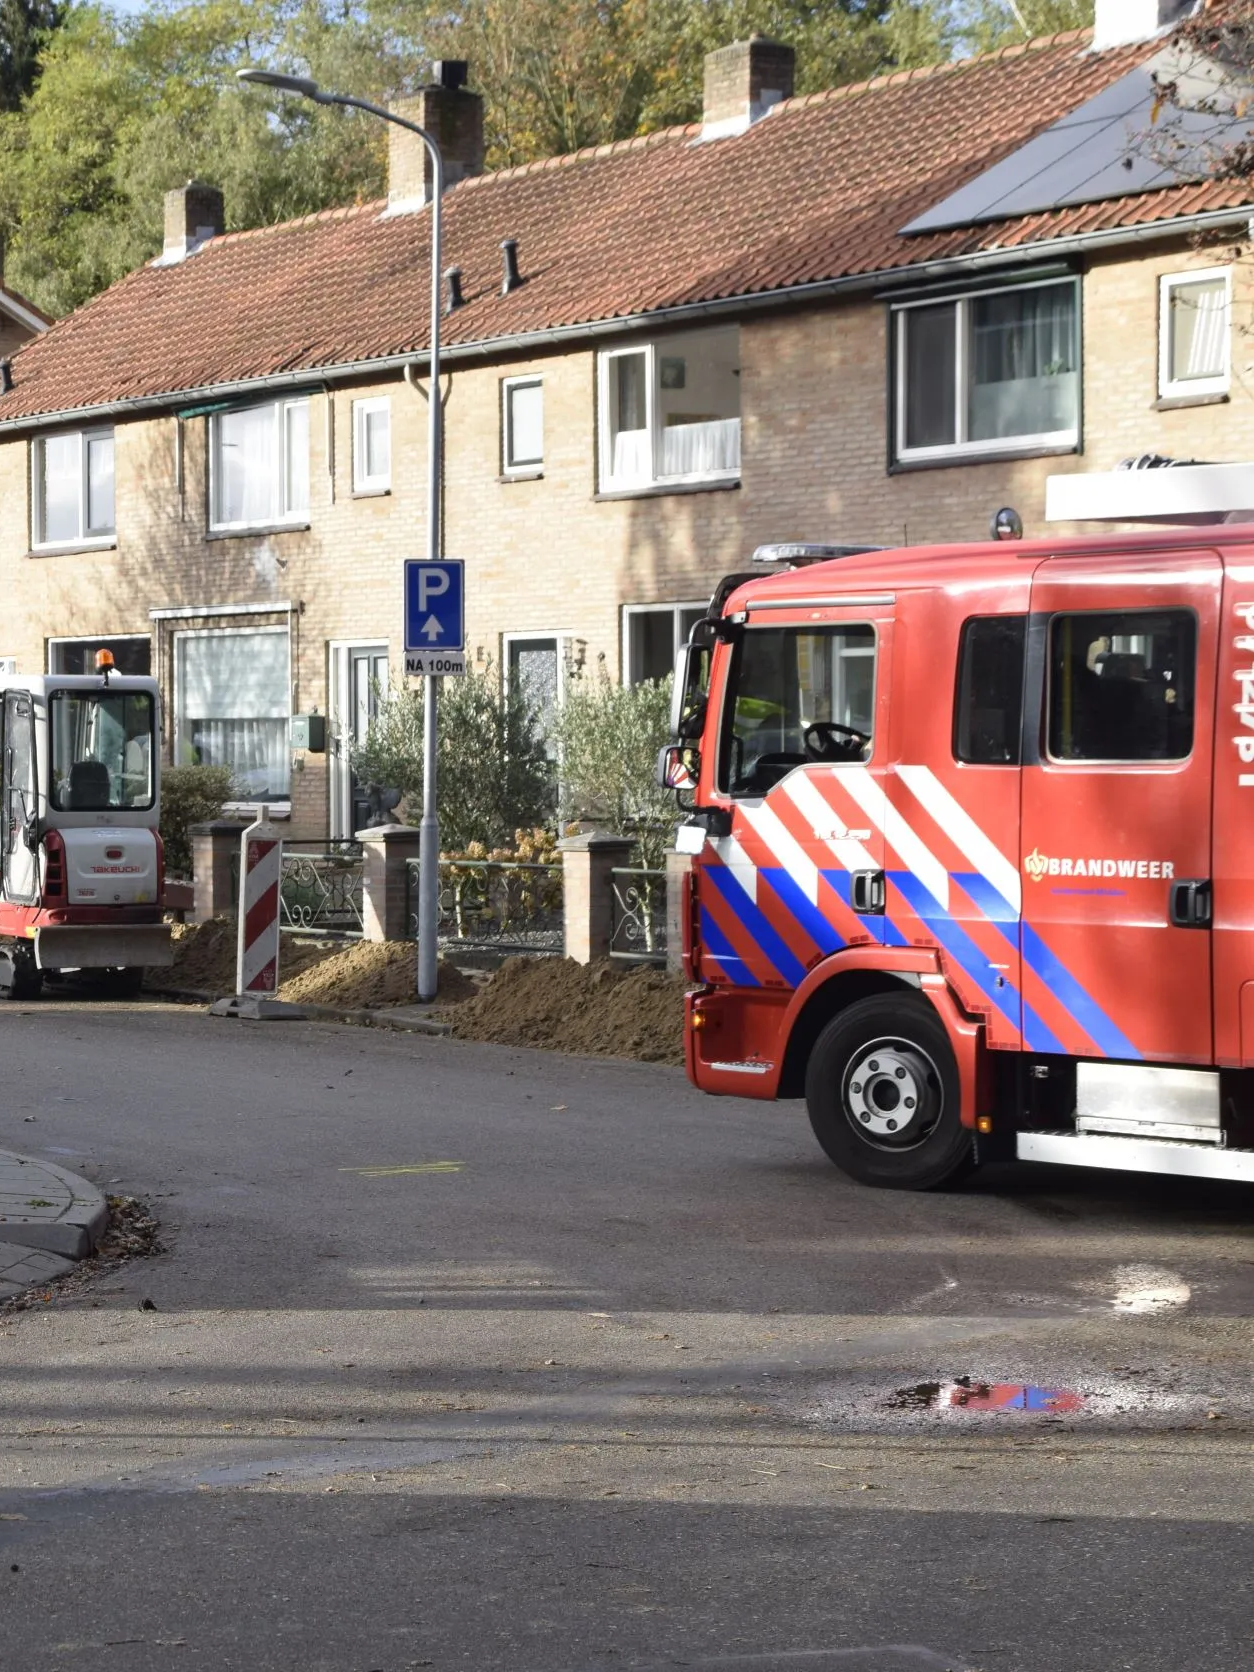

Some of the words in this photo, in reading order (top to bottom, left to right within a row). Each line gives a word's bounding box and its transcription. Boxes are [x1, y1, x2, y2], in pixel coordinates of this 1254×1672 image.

[418, 568, 450, 612] P
[406, 659, 424, 671] NA
[429, 660, 463, 672] 100m
[90, 865, 140, 873] TAKEUCHI
[1048, 858, 1175, 879] BRANDWEER
